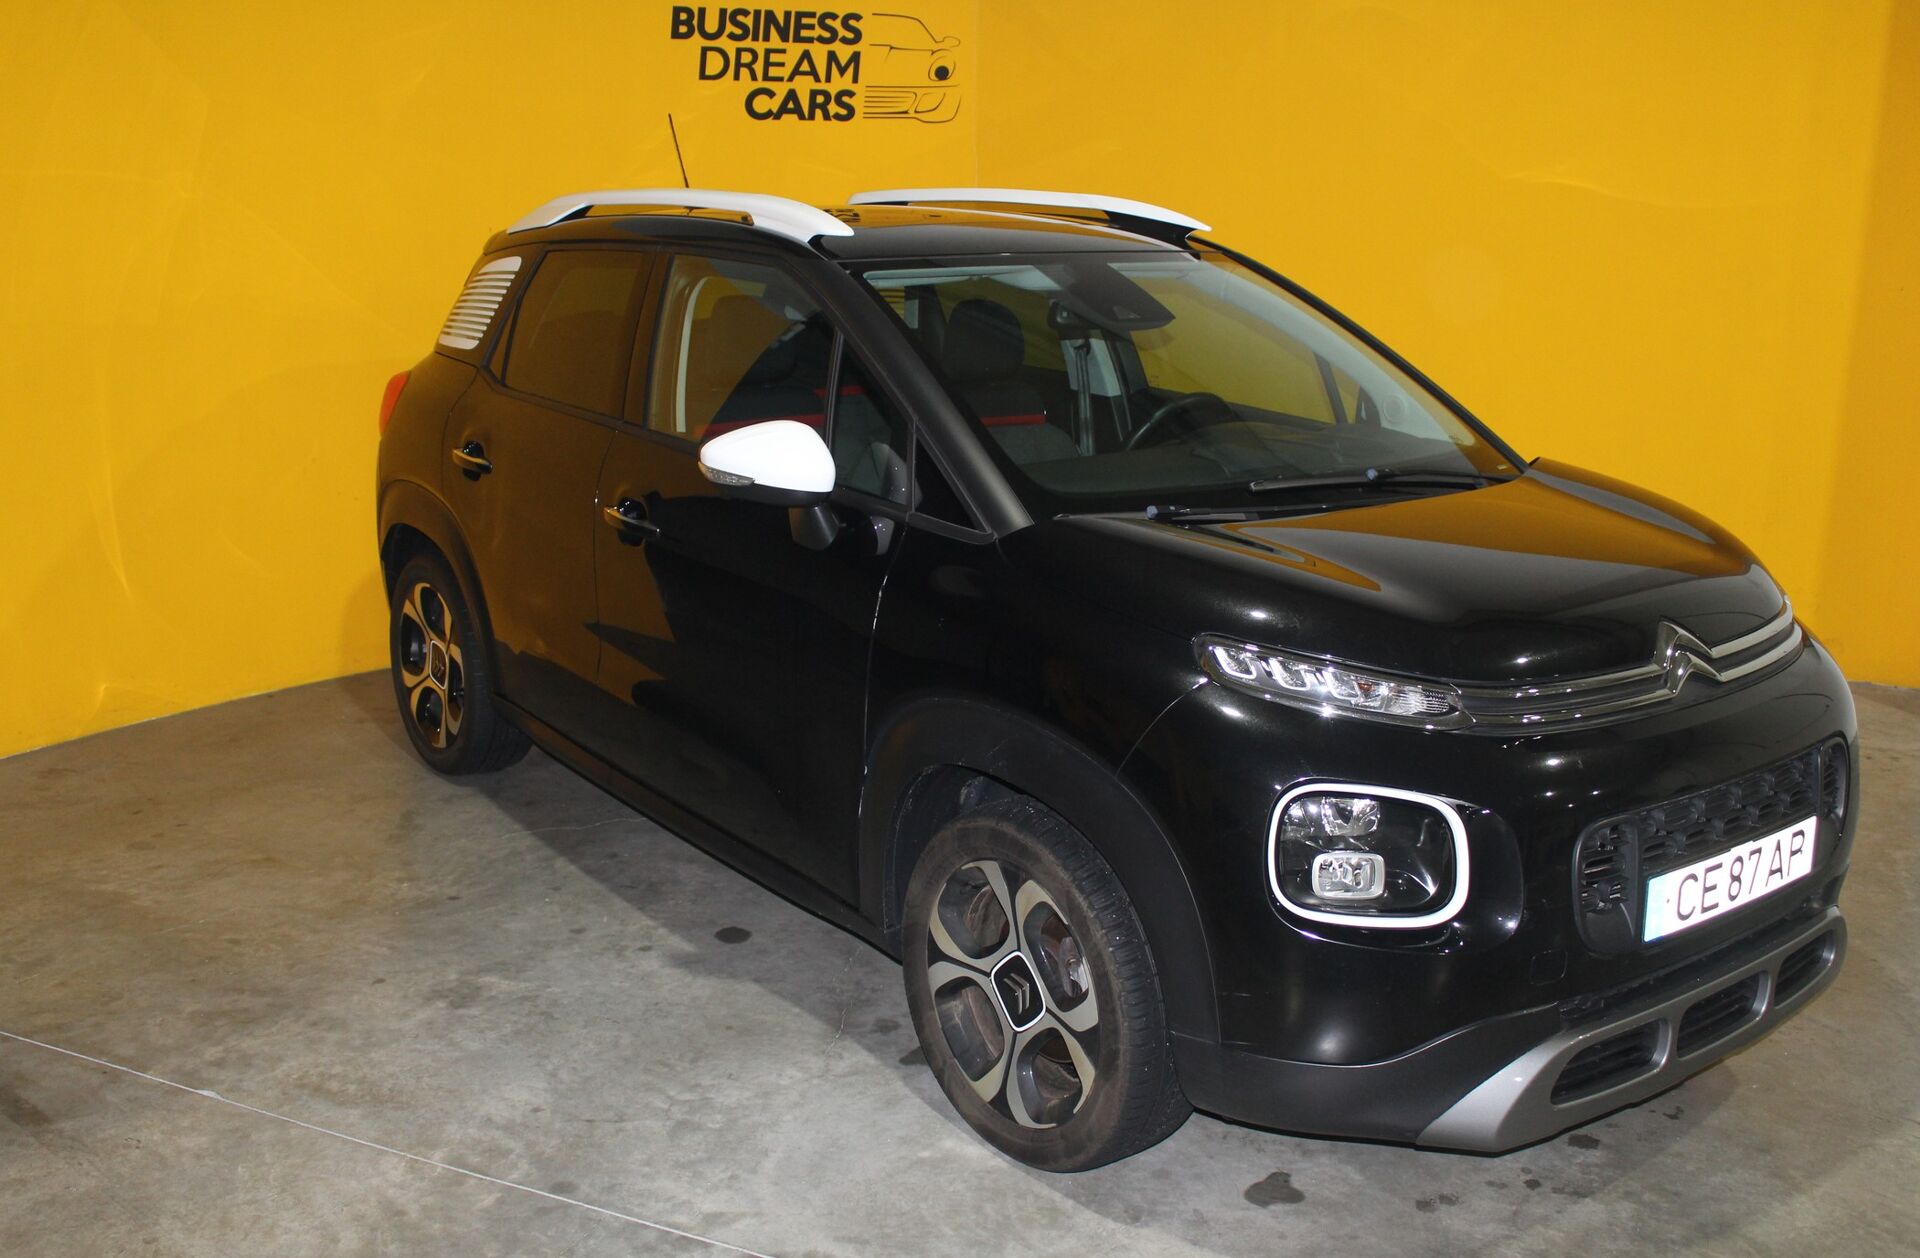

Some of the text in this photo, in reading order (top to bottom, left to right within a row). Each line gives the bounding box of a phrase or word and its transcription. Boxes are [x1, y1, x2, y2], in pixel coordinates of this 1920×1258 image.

[670, 6, 863, 45] BUSINESS
[698, 46, 861, 84] DREAM
[744, 87, 857, 122] CARS
